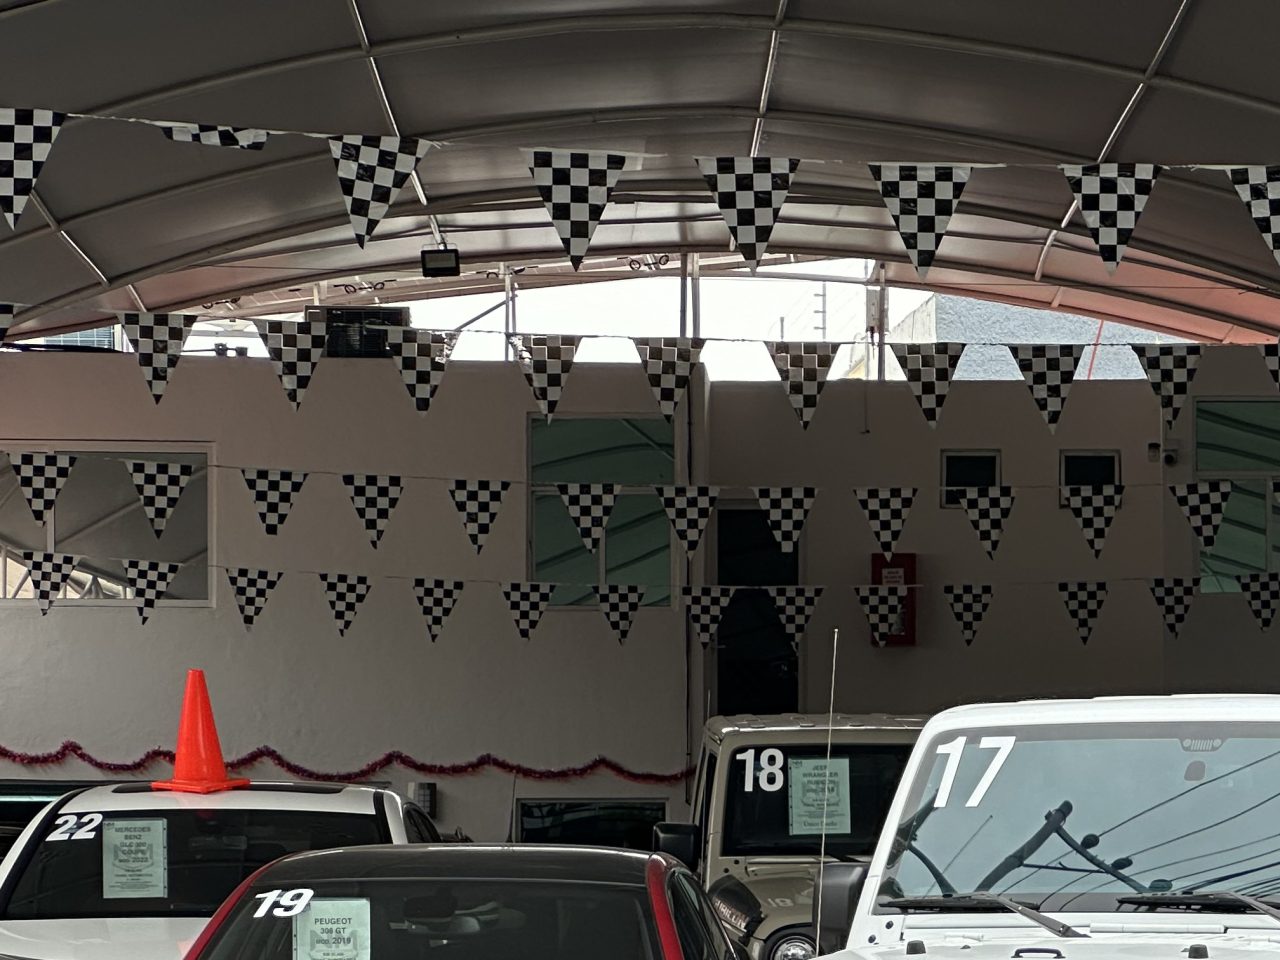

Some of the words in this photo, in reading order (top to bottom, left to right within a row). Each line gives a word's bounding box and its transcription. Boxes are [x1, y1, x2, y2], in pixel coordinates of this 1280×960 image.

[735, 748, 784, 792] 18
[933, 736, 1017, 808] 17
[45, 813, 103, 841] 22
[253, 888, 315, 918] 19
[314, 917, 353, 925] PEUGEOT
[335, 927, 347, 935] GT
